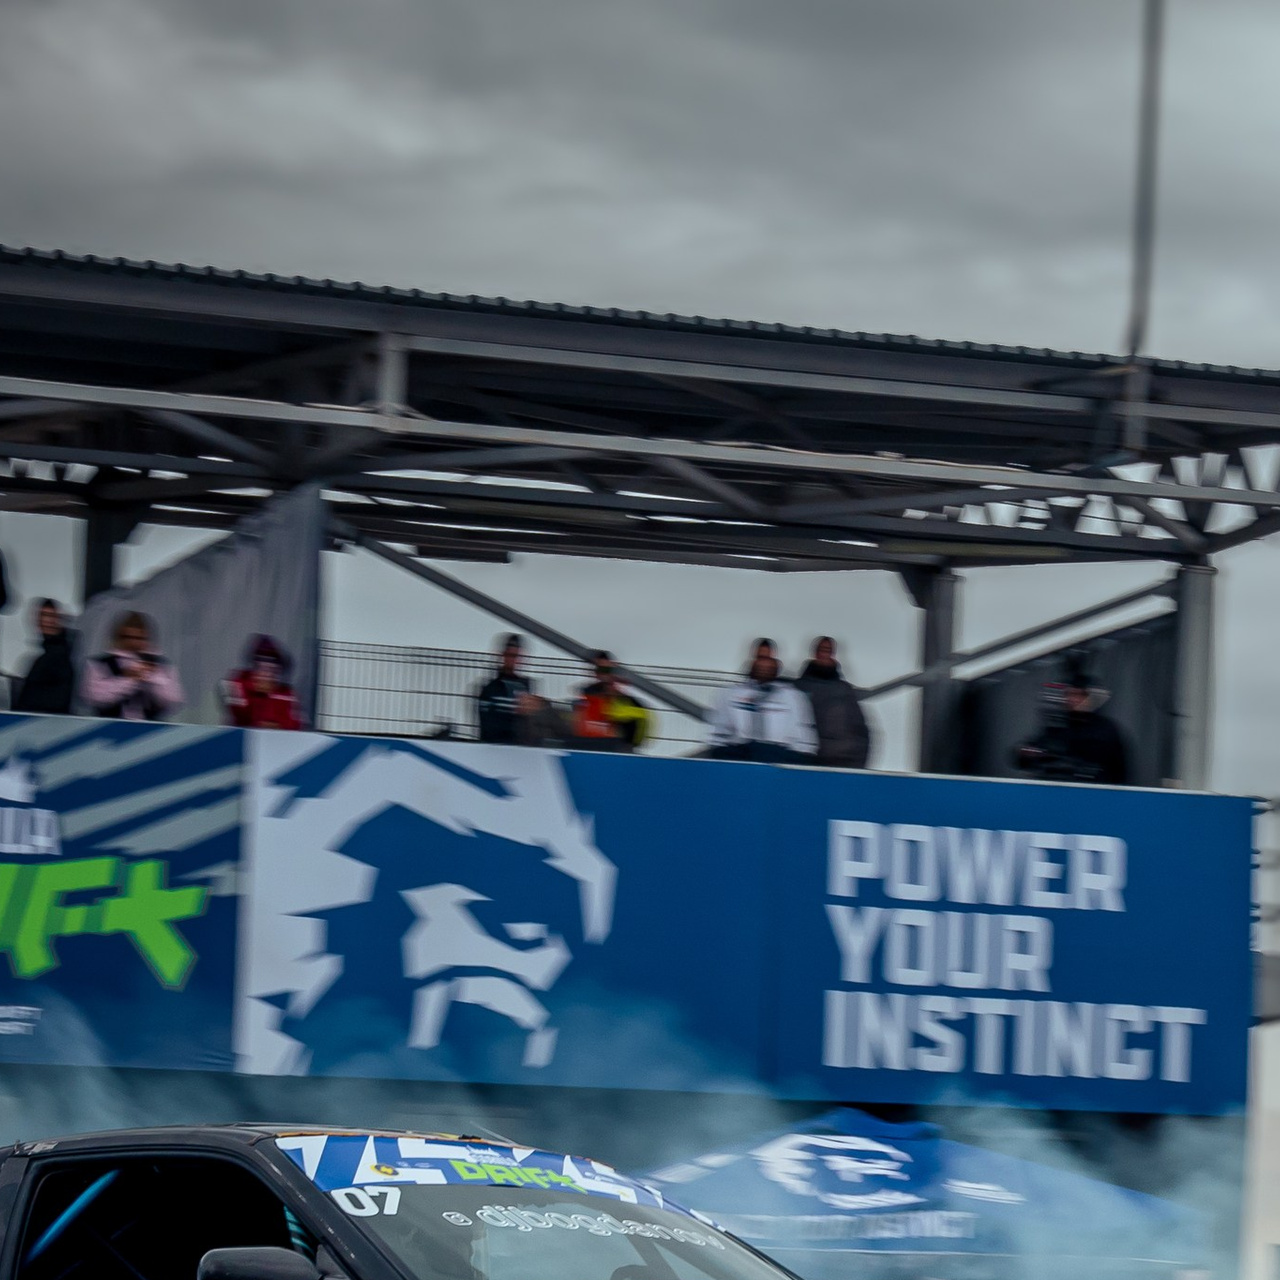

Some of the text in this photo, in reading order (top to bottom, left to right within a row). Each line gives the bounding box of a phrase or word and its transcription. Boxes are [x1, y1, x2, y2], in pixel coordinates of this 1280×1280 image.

[826, 818, 1128, 912] POWER
[823, 903, 1054, 993] YOUR
[821, 989, 1207, 1083] INSTINCT
[331, 1185, 401, 1217] 07
[449, 1159, 588, 1194] DRIFT
